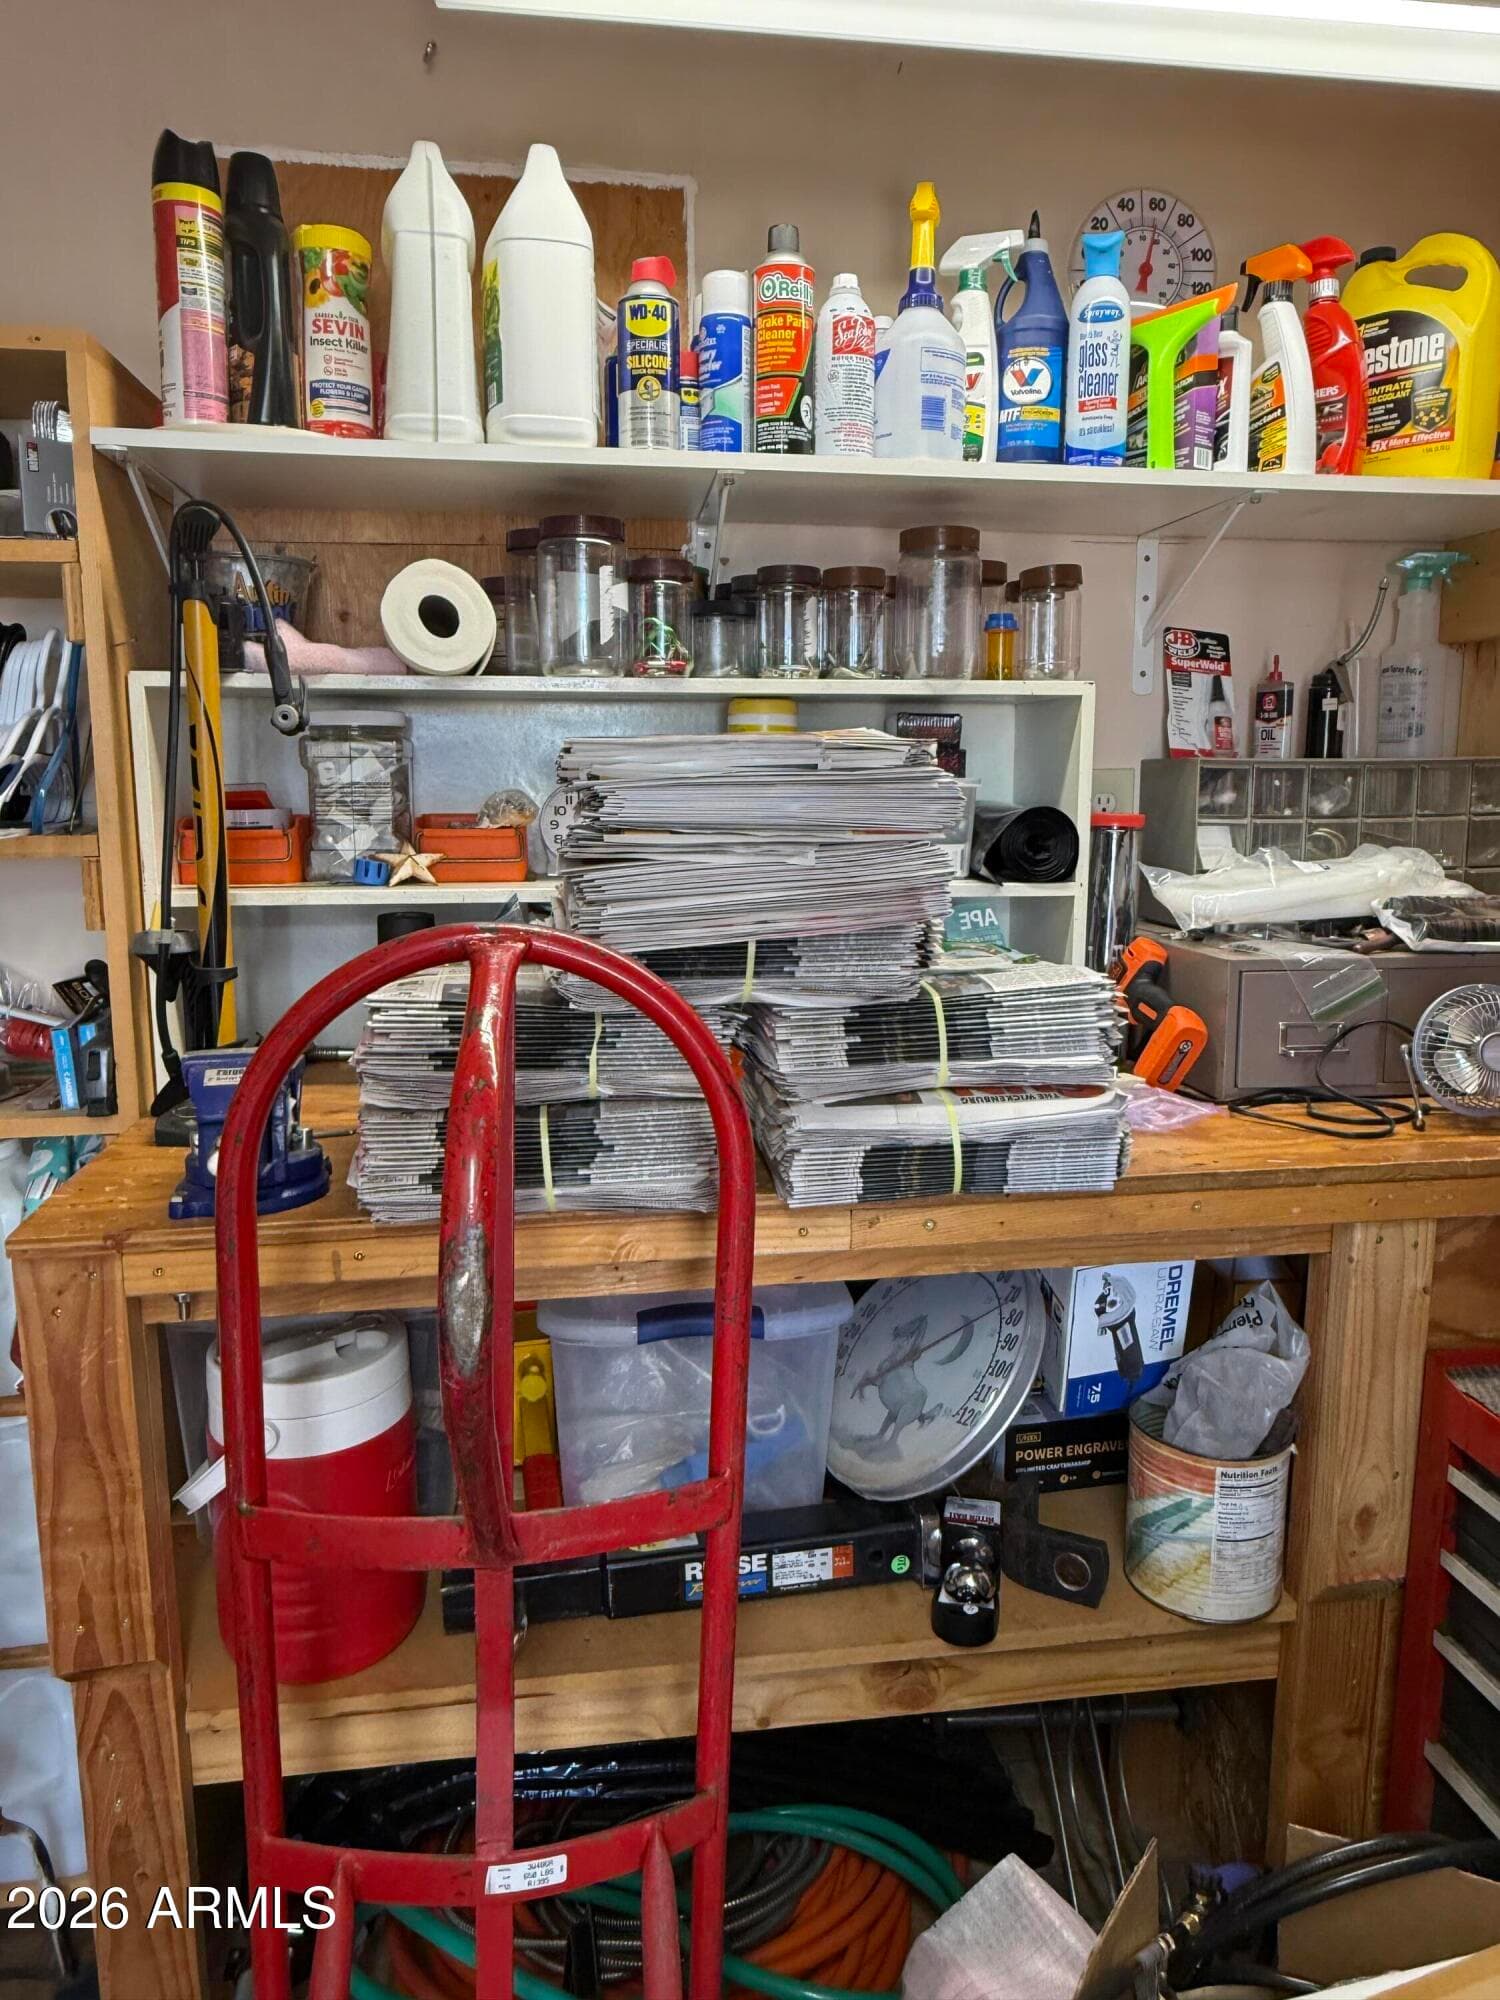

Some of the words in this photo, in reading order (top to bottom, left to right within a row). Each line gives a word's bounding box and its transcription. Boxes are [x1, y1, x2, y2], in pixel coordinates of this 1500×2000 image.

[1117, 198, 1135, 212] 40
[1149, 198, 1167, 212] 60
[1090, 216, 1109, 231] 20
[1177, 213, 1195, 228] 80
[1190, 248, 1212, 262] 100
[761, 273, 814, 308] O'Reilly
[1191, 282, 1212, 295] 120
[629, 304, 668, 322] WD-40
[1083, 309, 1120, 319] Sprayway
[311, 318, 365, 341] SEVIN
[758, 315, 784, 329] Brake
[757, 330, 797, 343] Cleaner
[310, 336, 343, 348] Insect
[345, 338, 368, 355] Killer
[626, 339, 669, 352] SPECIALIST
[626, 354, 672, 370] SILICONE
[1078, 340, 1108, 374] glass
[1364, 333, 1445, 376] estone
[1010, 388, 1041, 396] Valvoline
[1078, 371, 1119, 399] cleaner
[1000, 407, 1021, 423] MTF
[1371, 439, 1389, 453] 5X
[1389, 438, 1410, 448] More
[1412, 431, 1450, 444] Effective
[1171, 657, 1225, 672] SuperWeld
[1261, 729, 1276, 741] OIL
[565, 795, 573, 805] 11
[553, 805, 567, 816] 10
[550, 820, 559, 830] 9
[961, 1093, 1036, 1105] WICKENBURG
[1151, 1267, 1168, 1315] ULTRA
[1159, 1264, 1183, 1351] DREMEL
[1005, 1308, 1024, 1327] 80
[1000, 1333, 1019, 1351] 90
[1149, 1318, 1162, 1351] SAW
[988, 1359, 1014, 1379] 100
[1016, 1446, 1063, 1462] POWER
[1220, 1471, 1258, 1479] Nutrition
[685, 1554, 767, 1581] RSE
